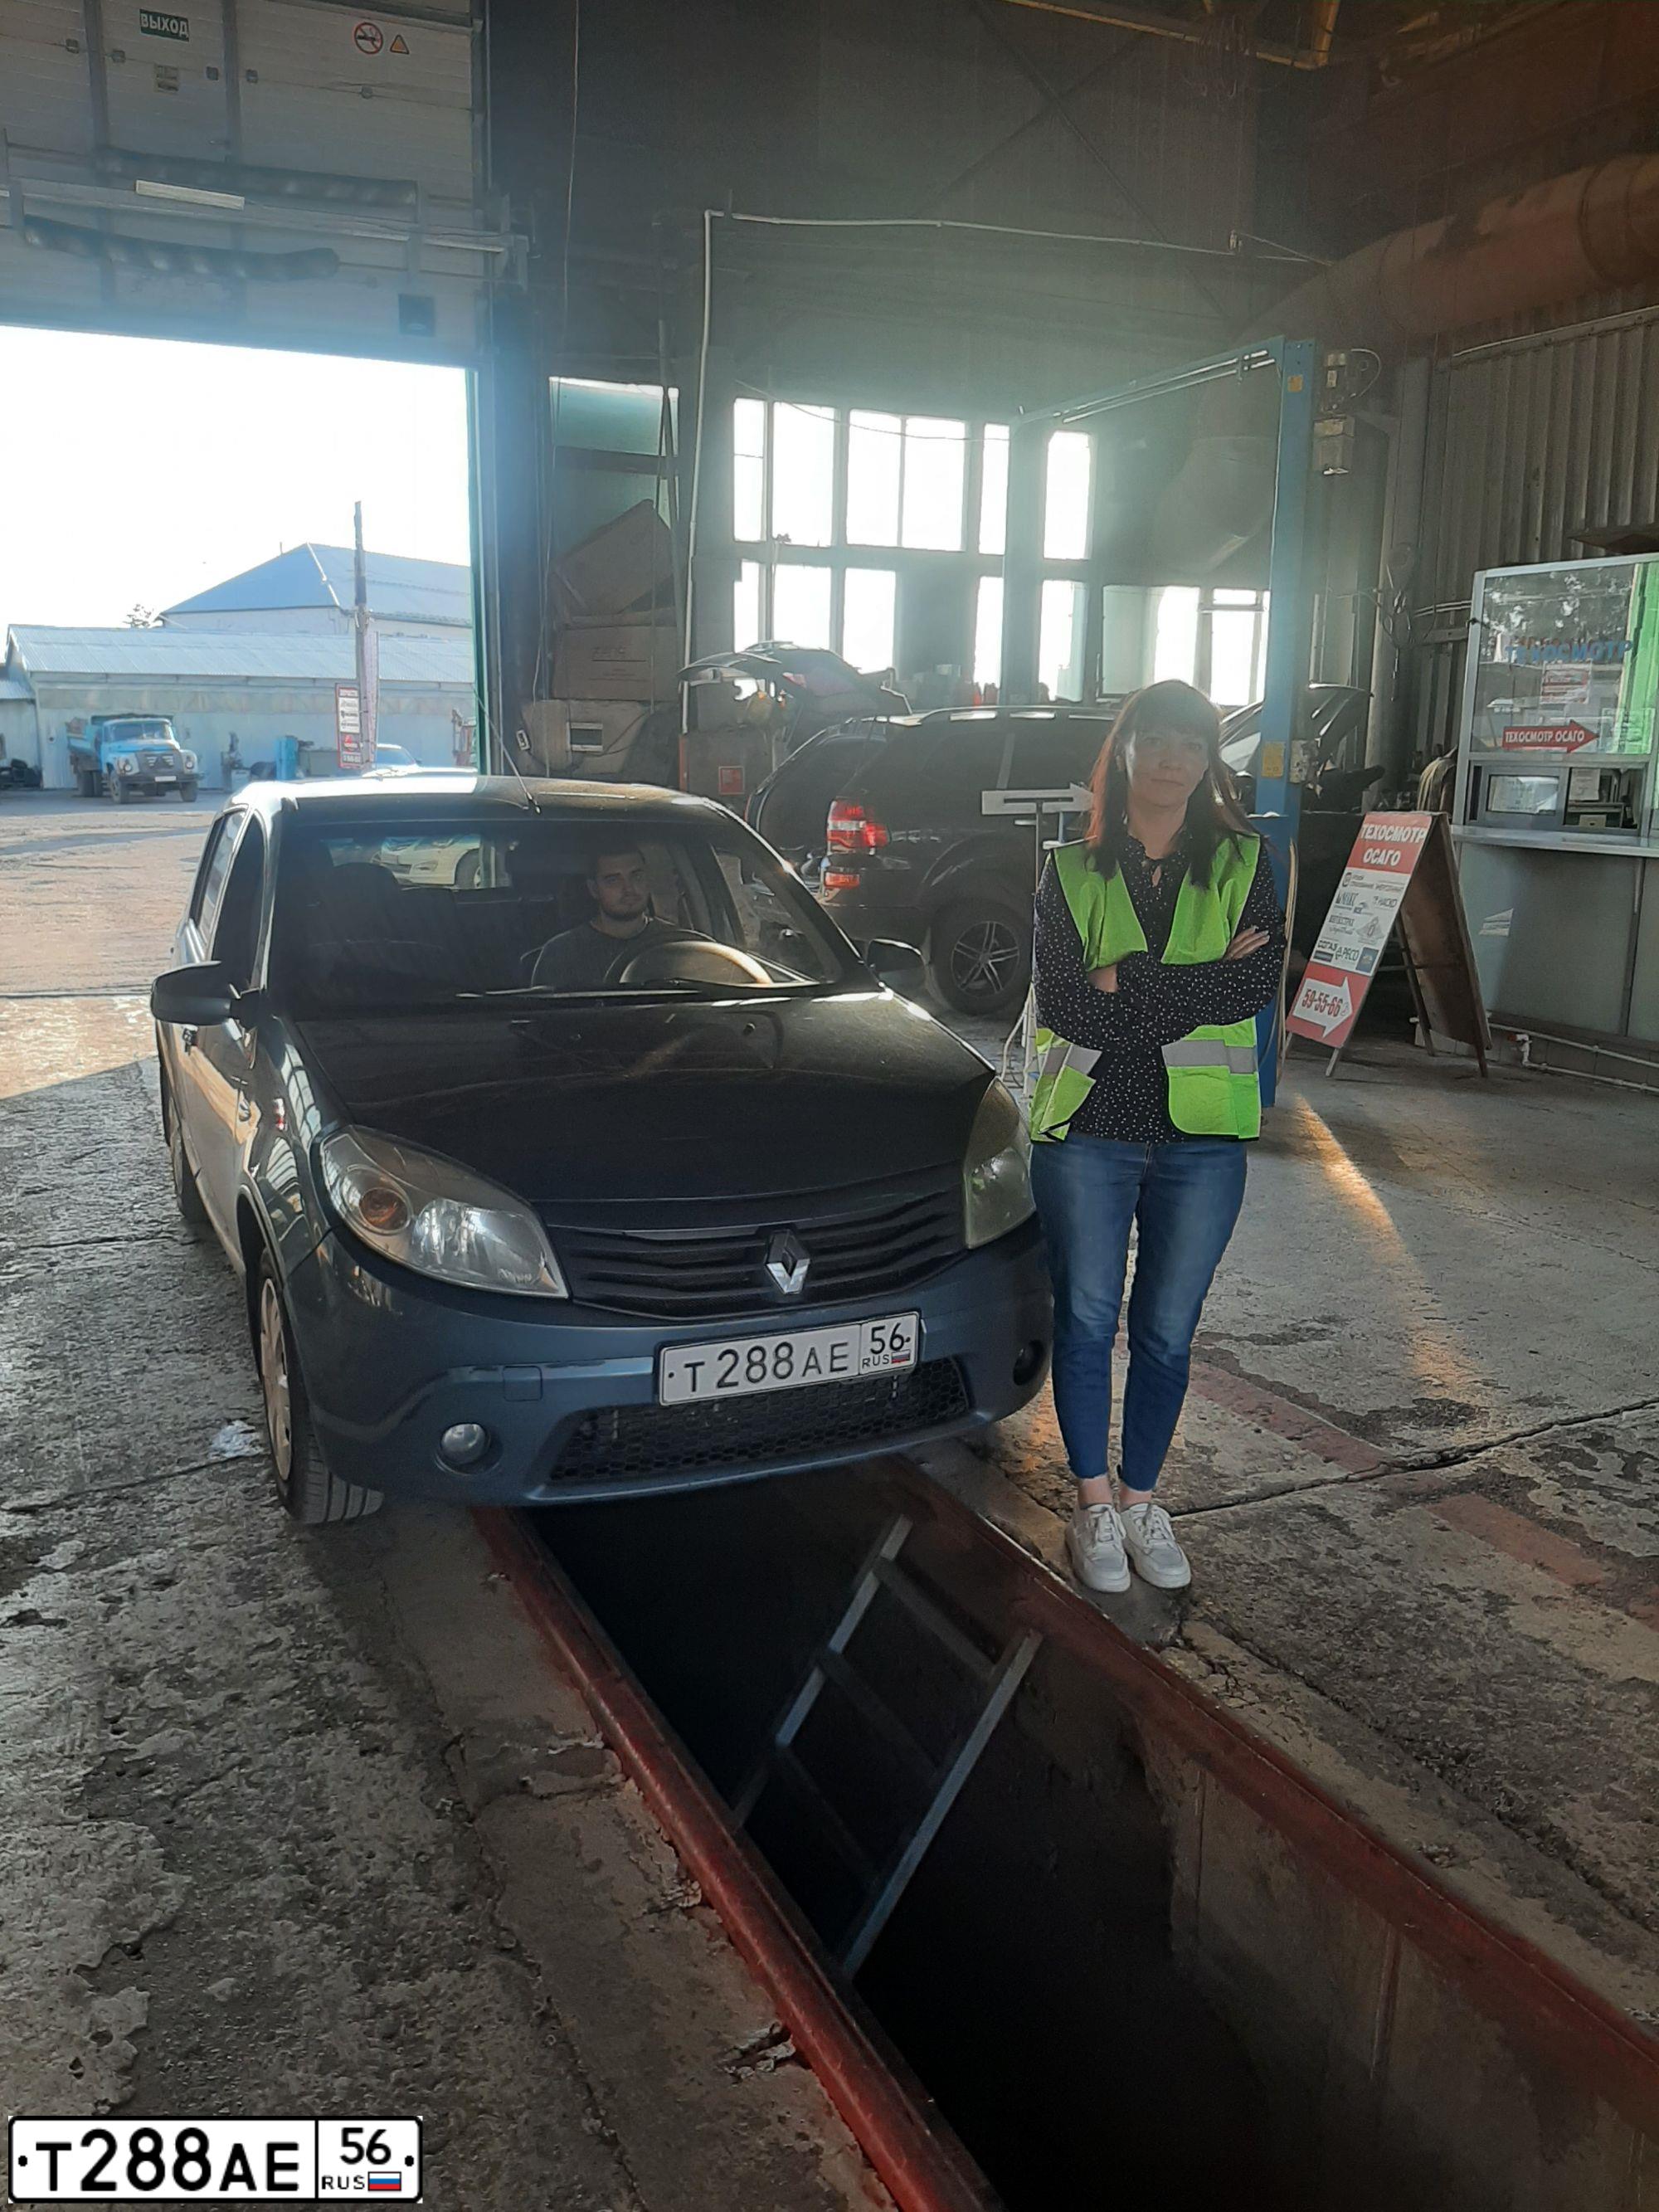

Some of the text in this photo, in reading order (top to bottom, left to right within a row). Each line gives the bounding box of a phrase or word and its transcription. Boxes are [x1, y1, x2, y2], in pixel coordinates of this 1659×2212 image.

[140, 12, 188, 38] ВЫХОД
[1505, 729, 1585, 743] ТЕХОСМОТР ОСАГО
[1360, 824, 1428, 844] ТЕХОСМОТР
[1363, 848, 1402, 866] ОСАГО
[1301, 988, 1343, 1017] 59-55-66
[870, 1323, 906, 1355] 56
[861, 1353, 890, 1370] RUS
